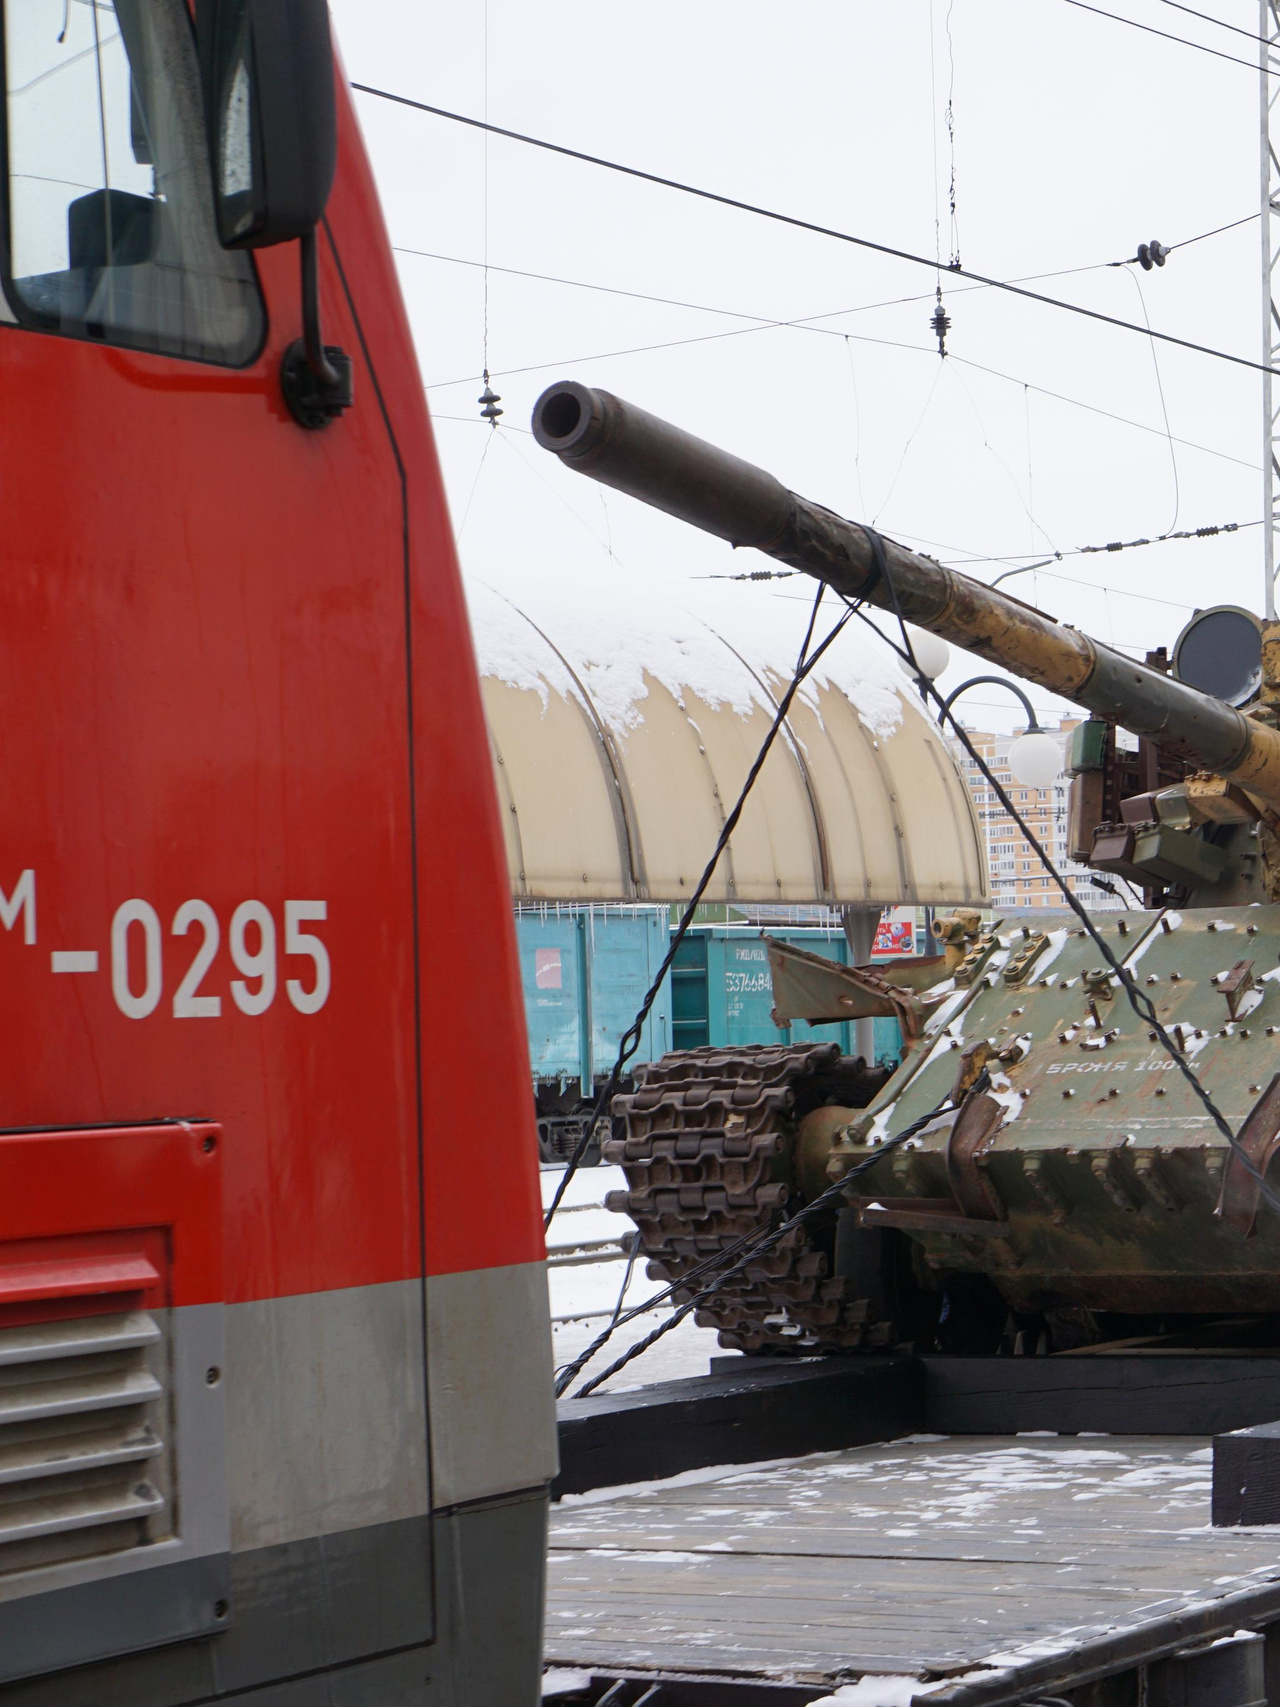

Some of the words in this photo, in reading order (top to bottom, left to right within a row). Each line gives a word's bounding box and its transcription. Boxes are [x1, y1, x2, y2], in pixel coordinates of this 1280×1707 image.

[725, 972, 773, 993] 5376684
[1046, 1061, 1130, 1074] БРОНЯ
[1134, 1059, 1201, 1072] 100м
